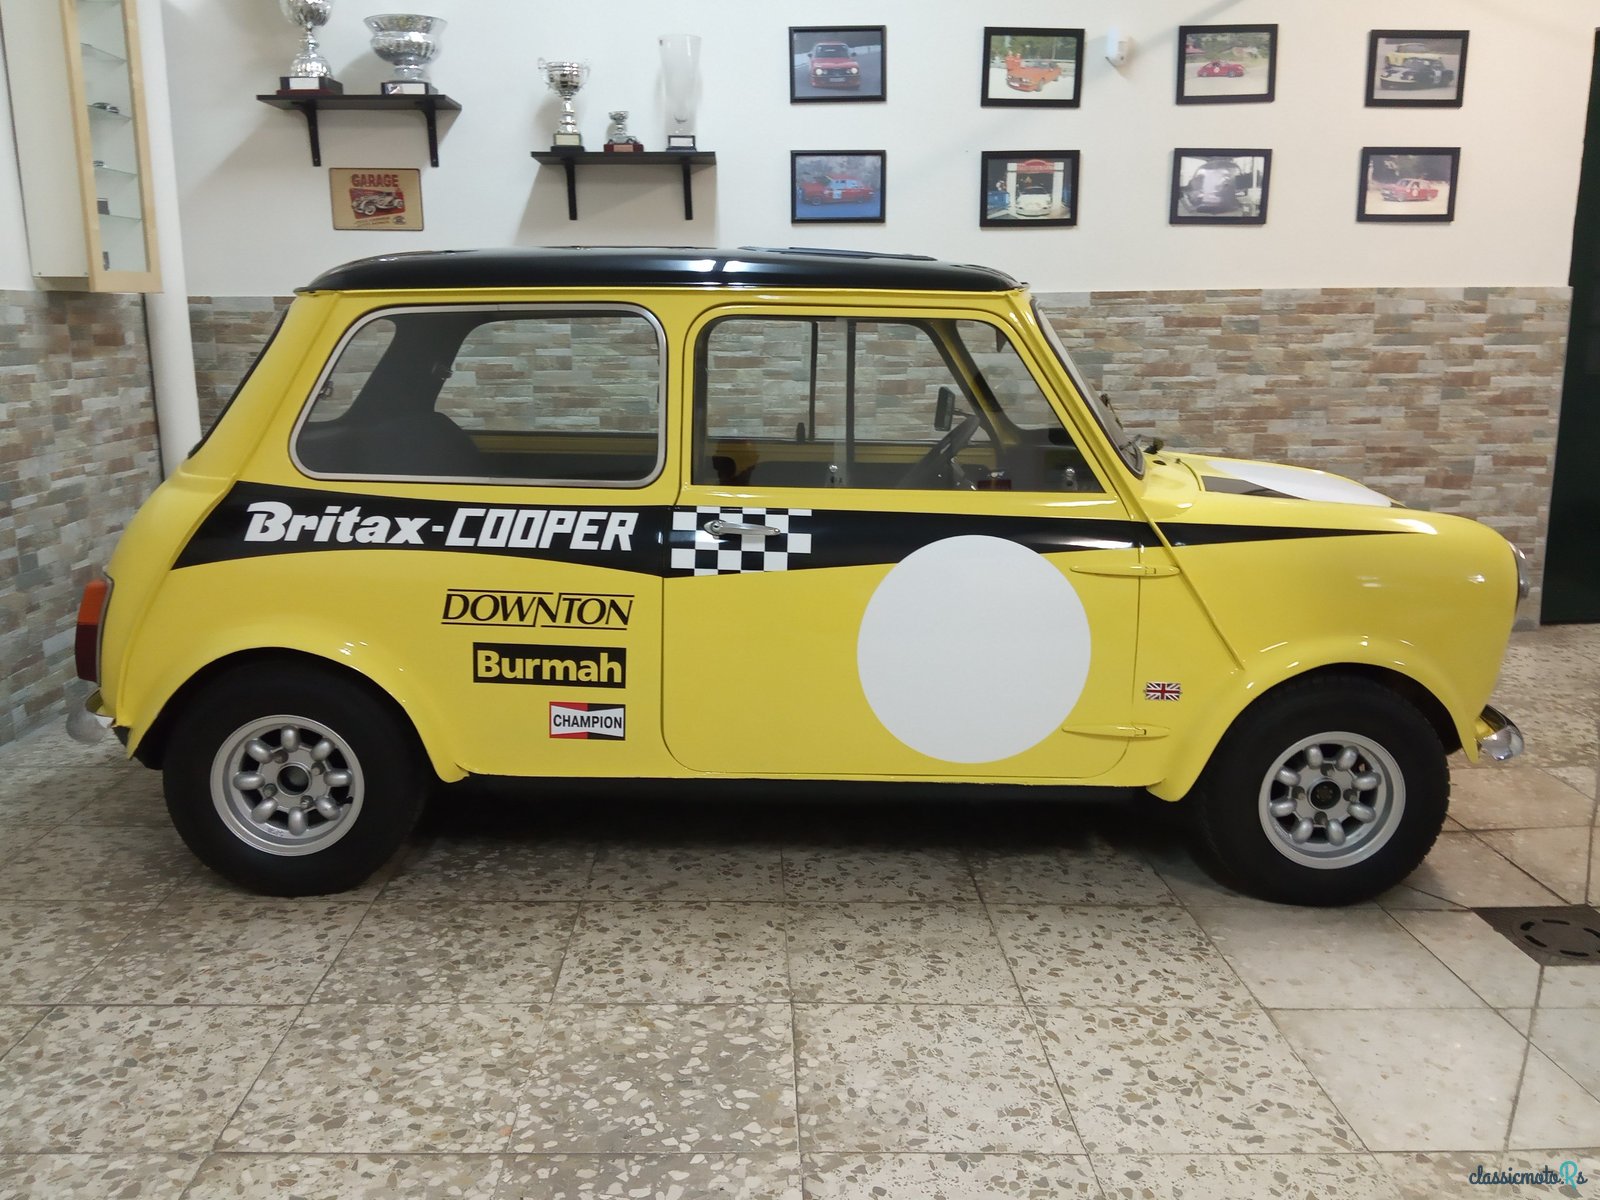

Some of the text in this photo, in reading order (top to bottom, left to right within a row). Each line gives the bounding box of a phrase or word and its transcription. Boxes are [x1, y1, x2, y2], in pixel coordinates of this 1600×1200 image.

[351, 173, 399, 188] GARAGE
[243, 501, 639, 552] Britax-COOPER
[441, 589, 635, 630] DOWNTON
[476, 649, 623, 684] Burmah
[552, 713, 623, 730] CHAMPION
